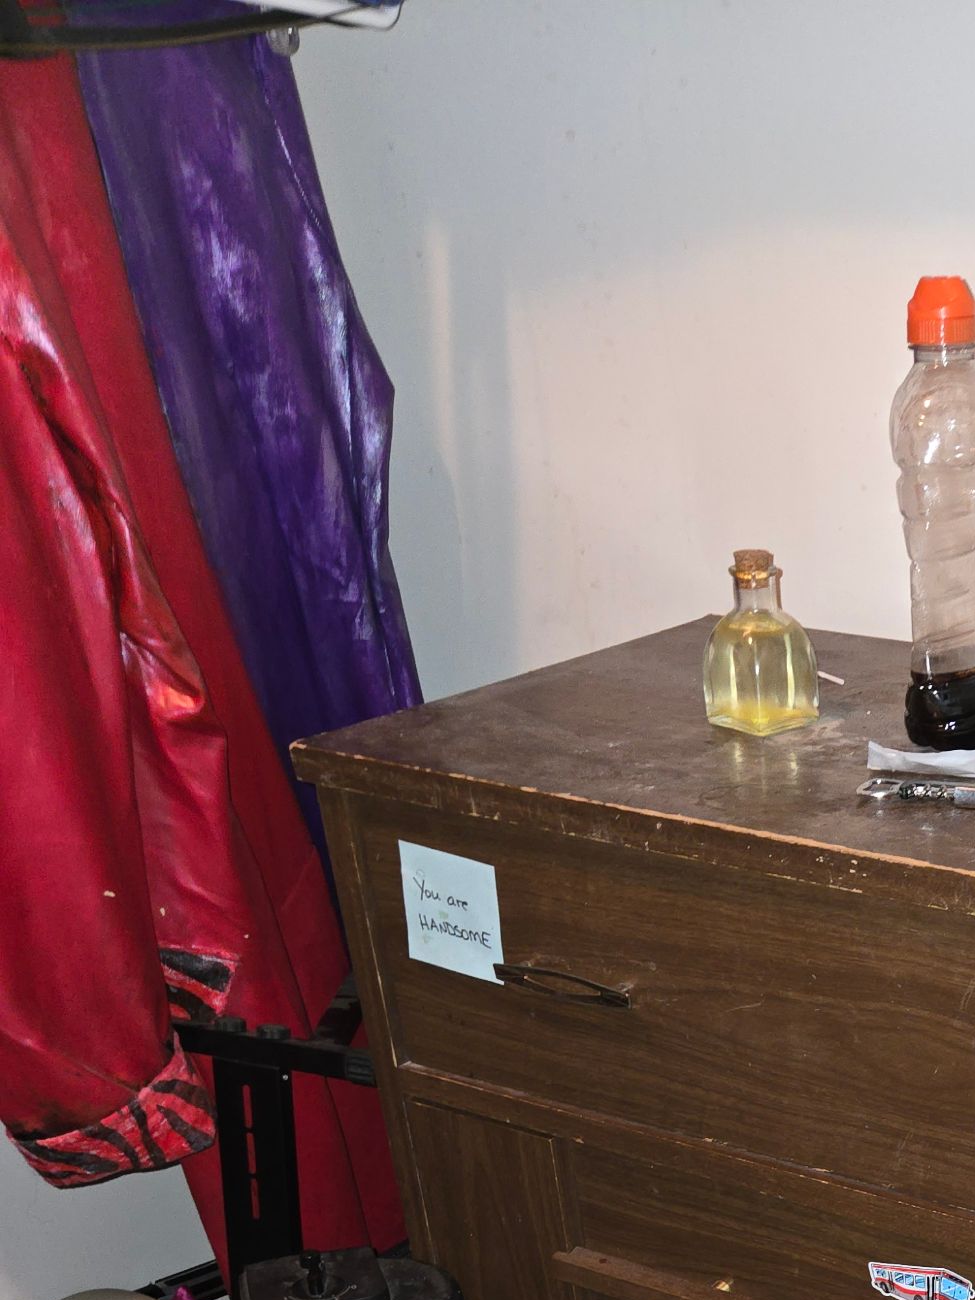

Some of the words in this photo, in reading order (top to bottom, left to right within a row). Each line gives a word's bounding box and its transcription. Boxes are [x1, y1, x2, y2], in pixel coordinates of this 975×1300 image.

[413, 876, 441, 901] You
[447, 896, 468, 911] are
[418, 913, 492, 949] HANDSOME
